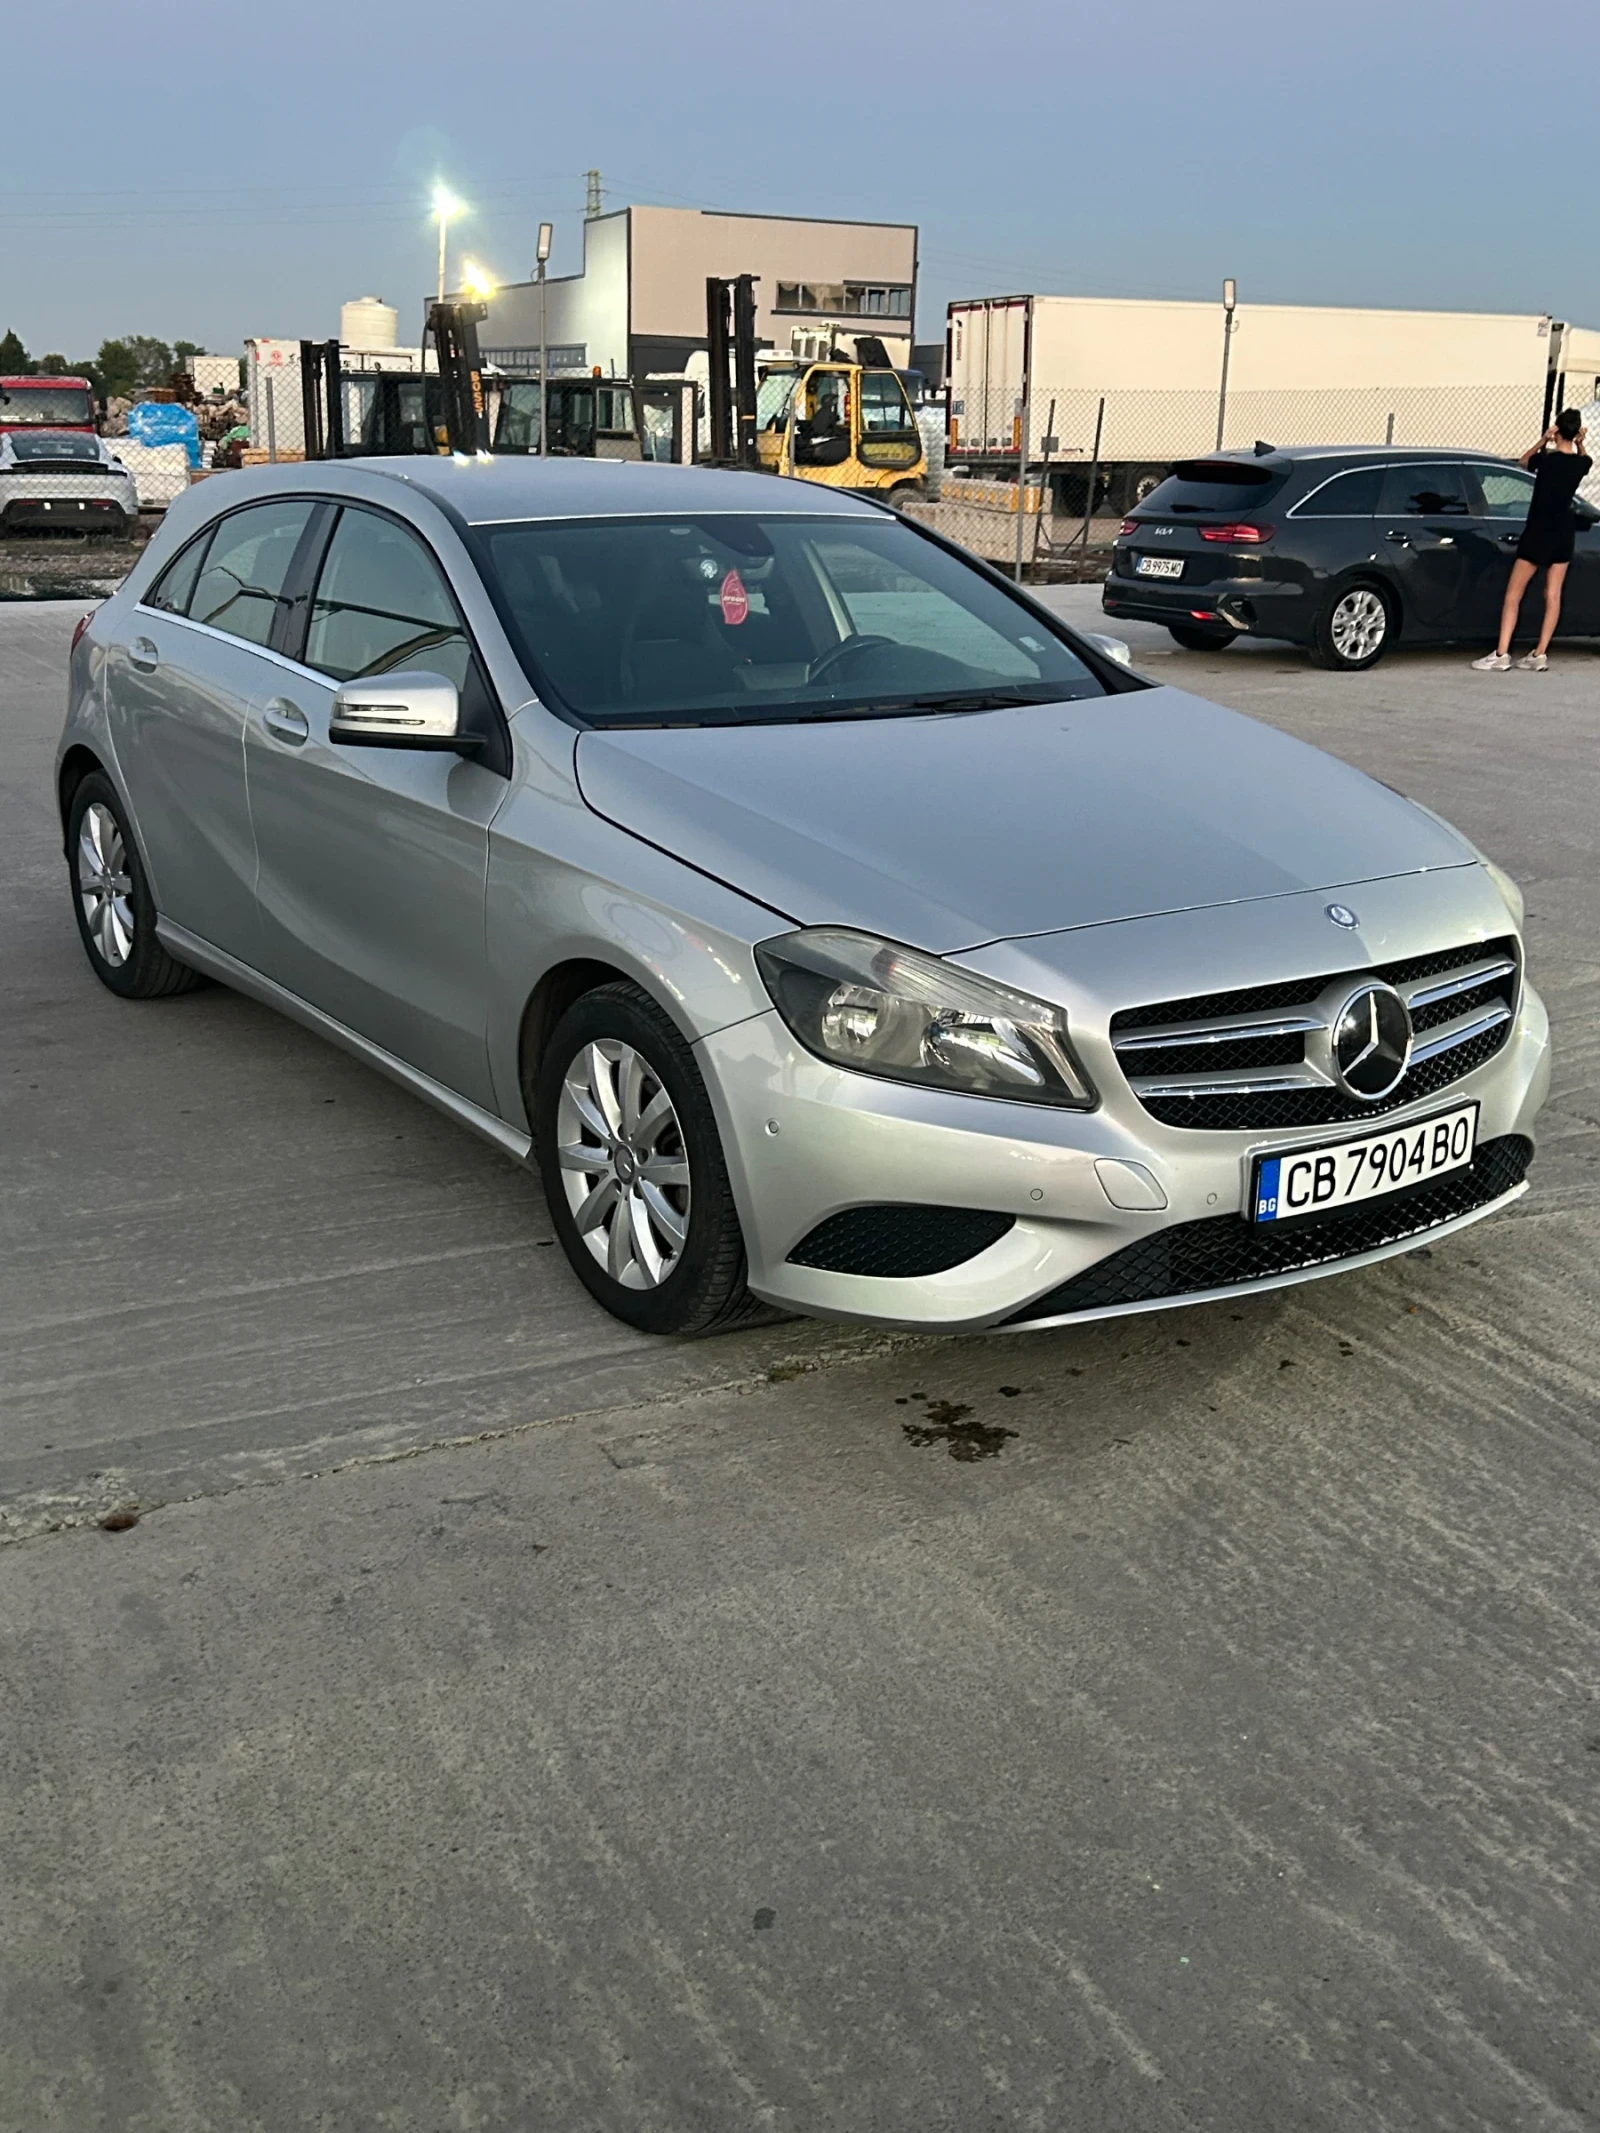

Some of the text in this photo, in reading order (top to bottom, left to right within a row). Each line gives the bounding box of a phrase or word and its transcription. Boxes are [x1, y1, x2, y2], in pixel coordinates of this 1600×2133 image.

[470, 371, 483, 413] BOSS
[1141, 559, 1151, 571] CB
[1152, 561, 1169, 573] 9975
[1169, 562, 1181, 574] MO
[1286, 1117, 1470, 1208] CB 7904 BO
[1258, 1198, 1276, 1214] BG
